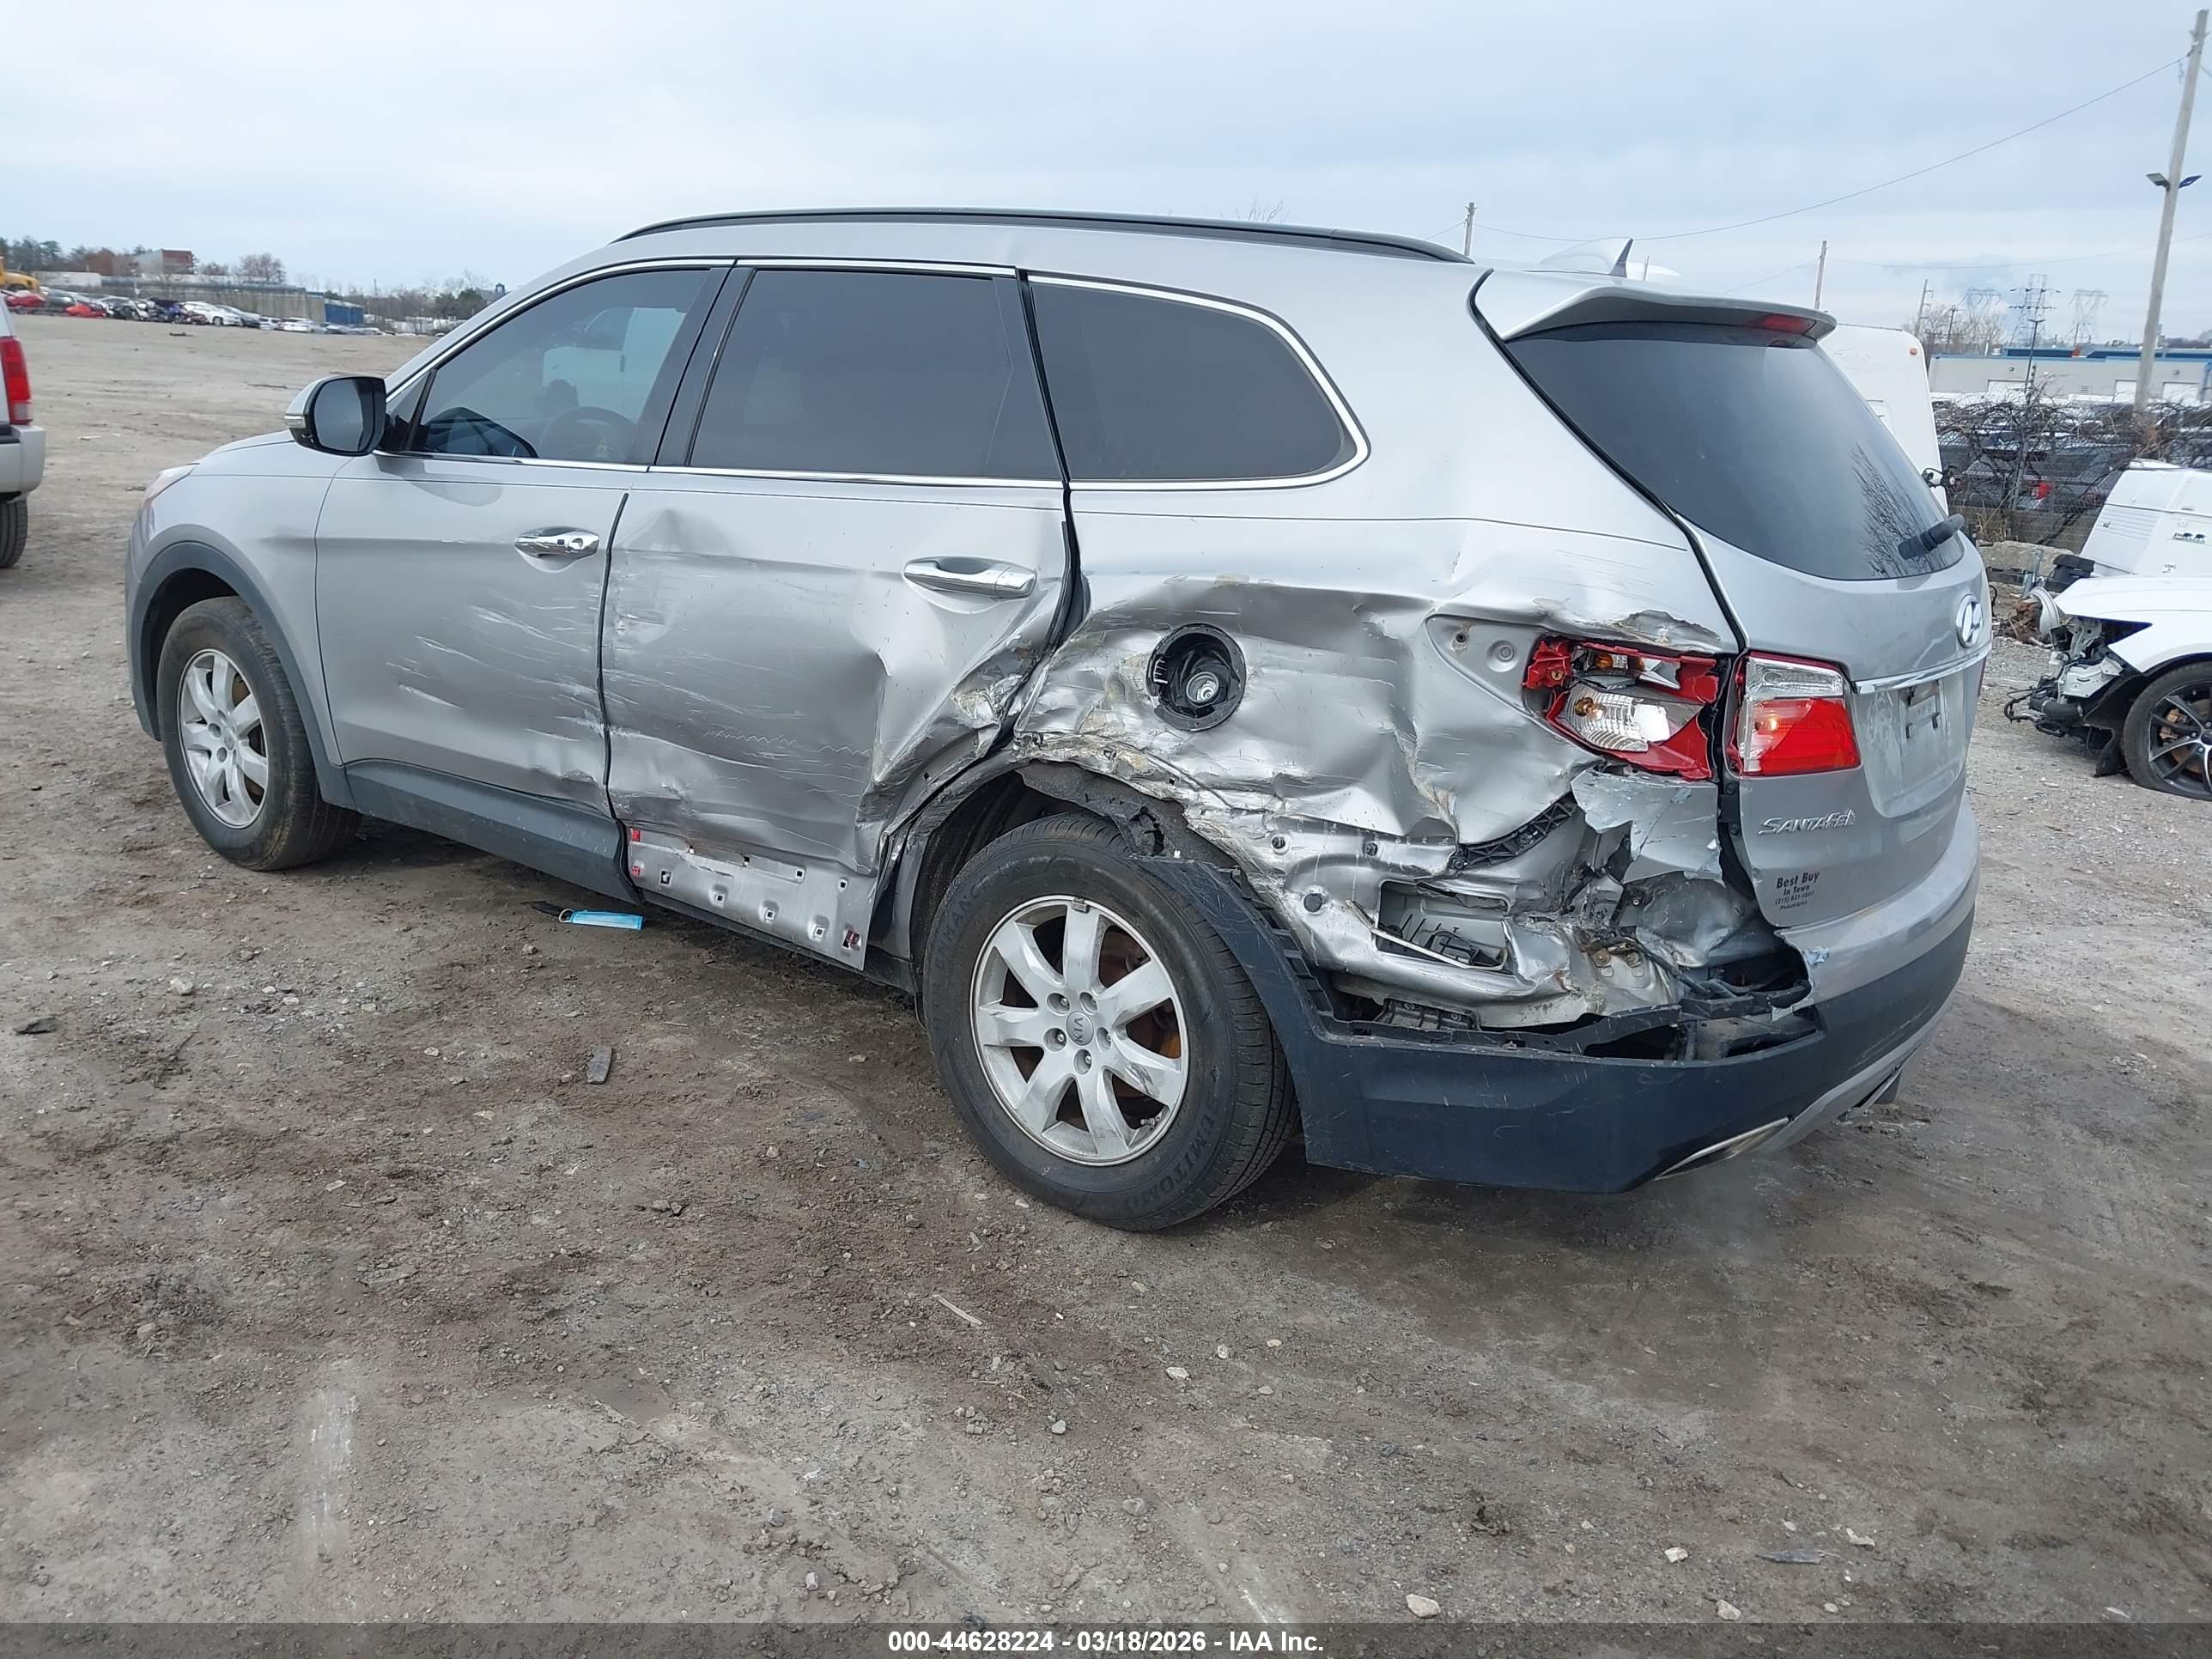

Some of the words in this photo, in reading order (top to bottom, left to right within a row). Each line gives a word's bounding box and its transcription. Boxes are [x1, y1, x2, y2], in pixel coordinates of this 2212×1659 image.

[1777, 875, 1799, 889] Best
[1802, 872, 1820, 884] Buy
[1793, 884, 1809, 894] Town
[1073, 1017, 1084, 1042] KIA
[1124, 1093, 1222, 1209] UMITOMO
